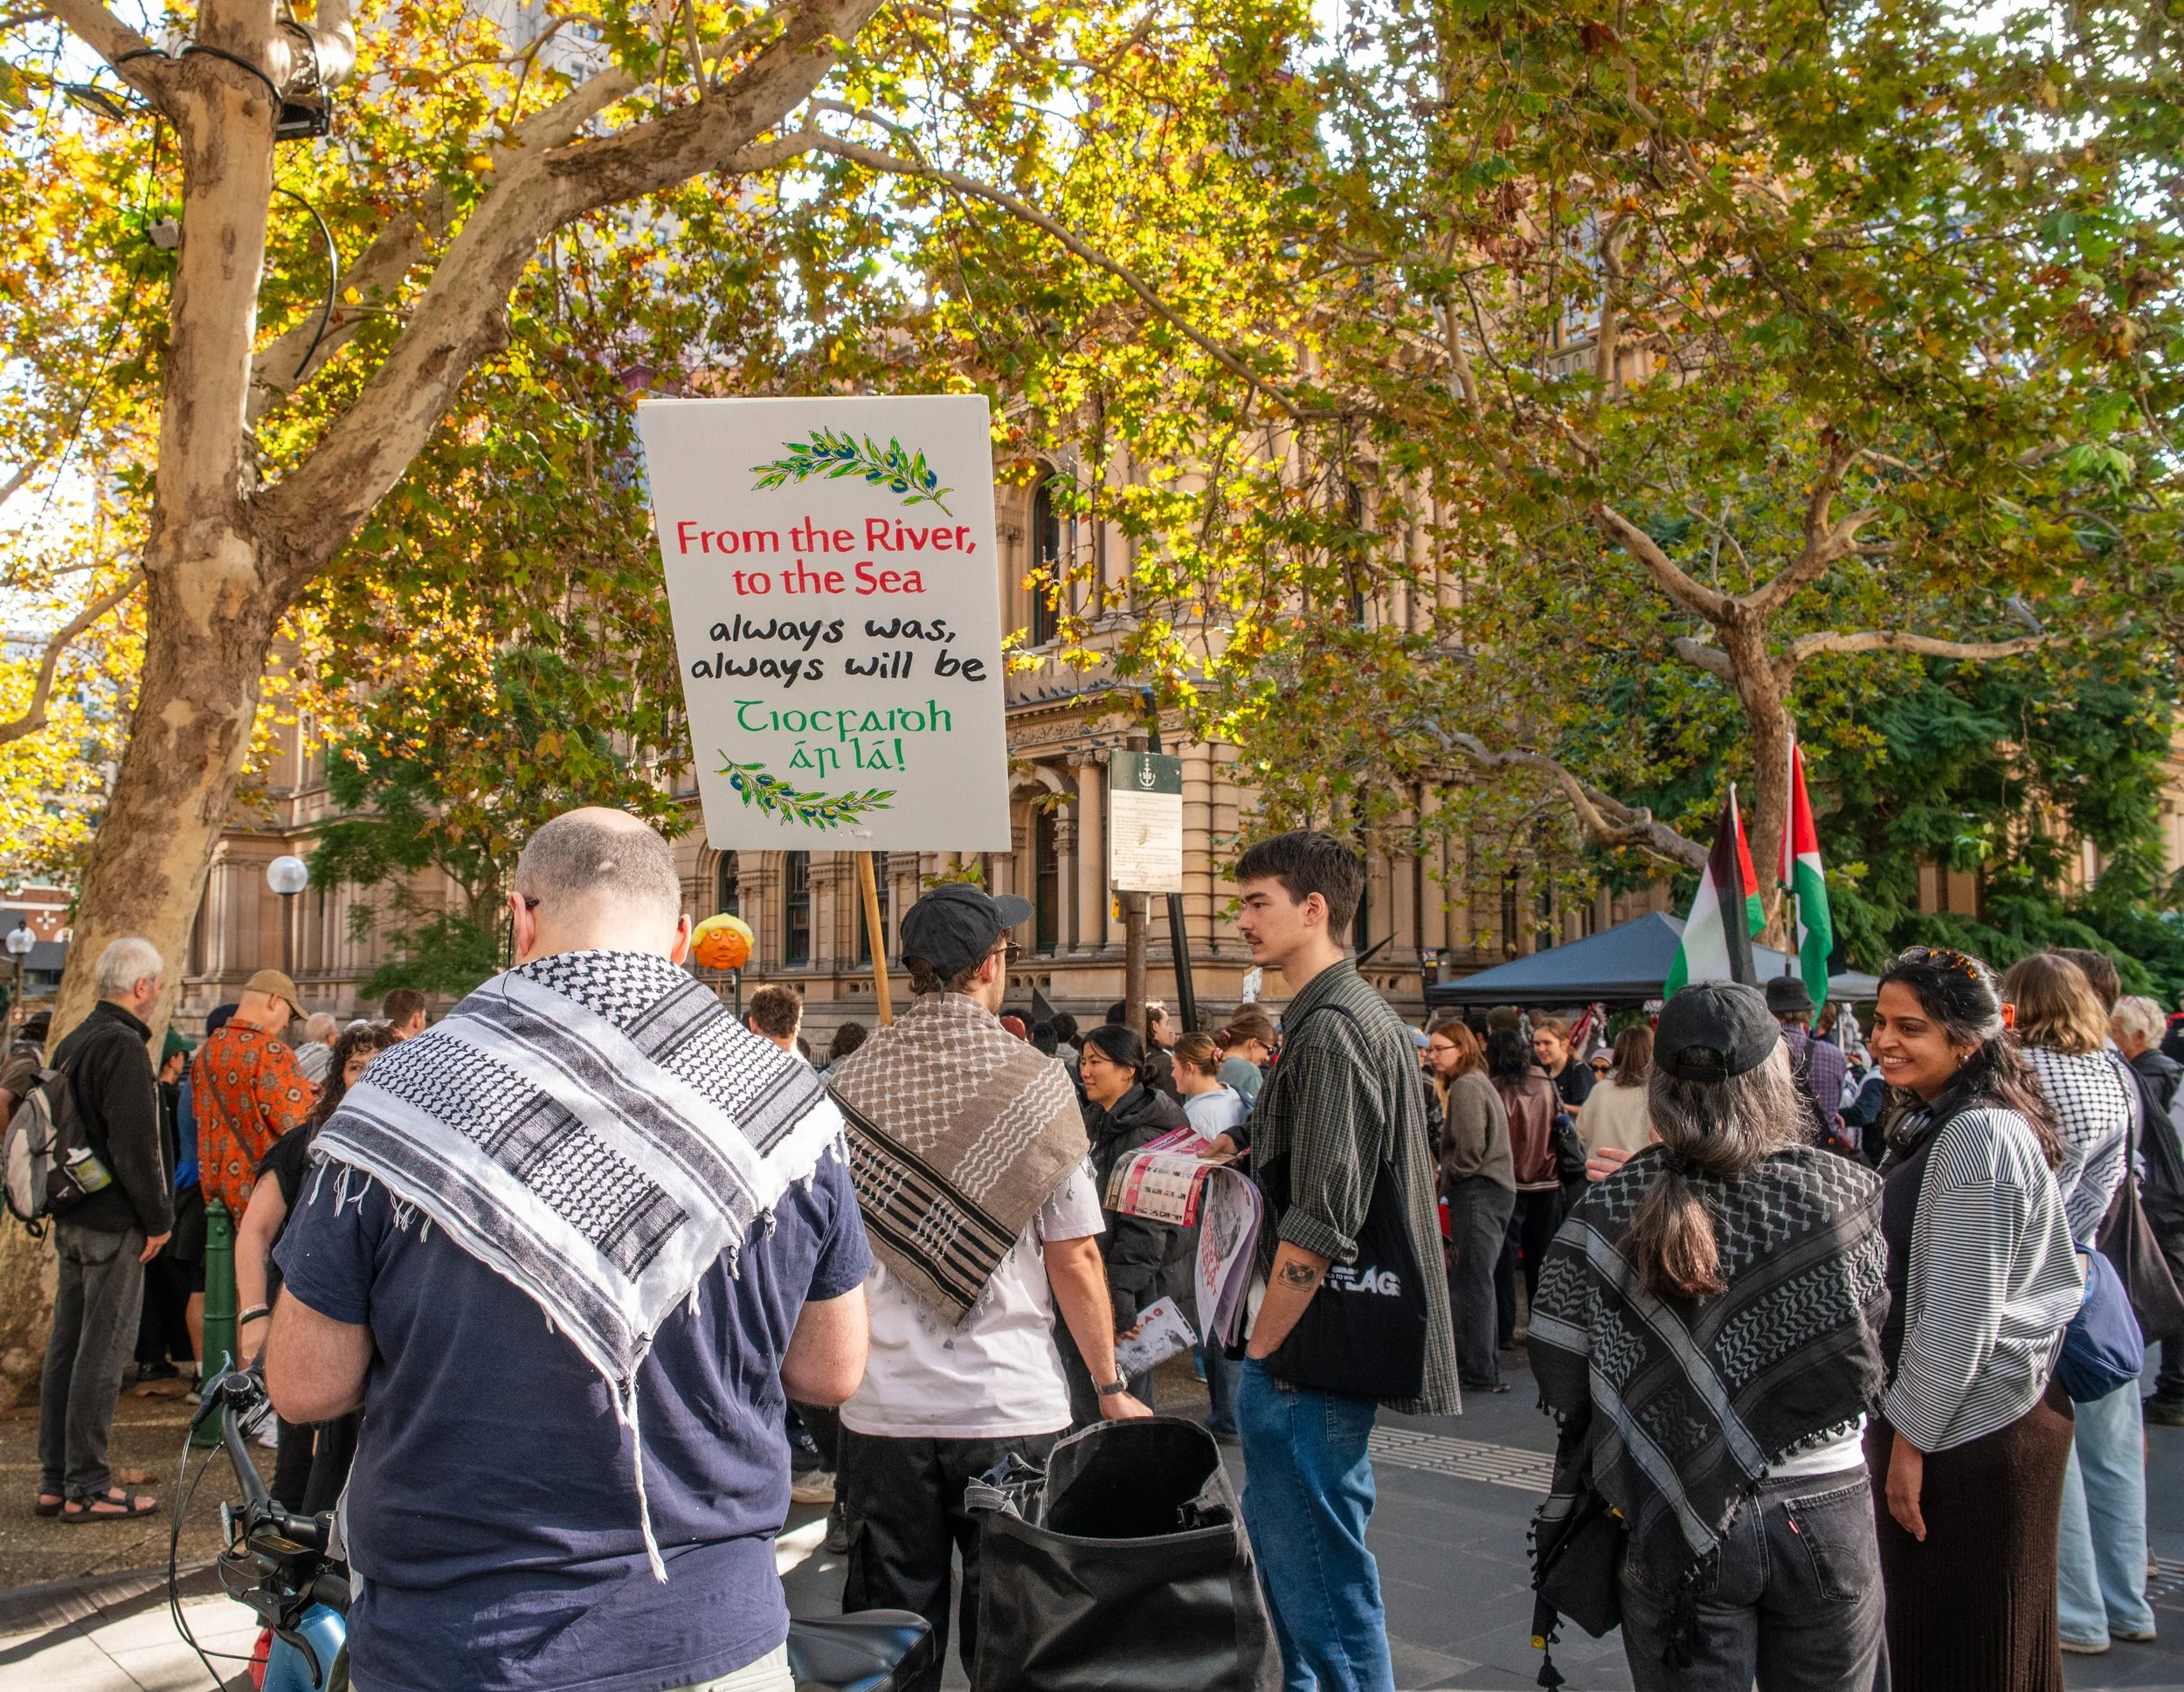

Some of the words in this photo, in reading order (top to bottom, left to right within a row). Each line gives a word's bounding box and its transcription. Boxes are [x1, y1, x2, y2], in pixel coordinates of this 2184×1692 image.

[677, 521, 780, 556] From
[788, 515, 855, 552] the
[865, 517, 978, 556] River,
[731, 569, 772, 596] to
[779, 559, 846, 595] the
[854, 560, 928, 596] Sea
[709, 613, 845, 652] always
[864, 618, 957, 645] was,
[690, 652, 824, 688] always
[844, 651, 914, 680] will
[934, 648, 988, 683] be
[733, 699, 952, 742] Tiocfaidh
[848, 737, 906, 772] lá!
